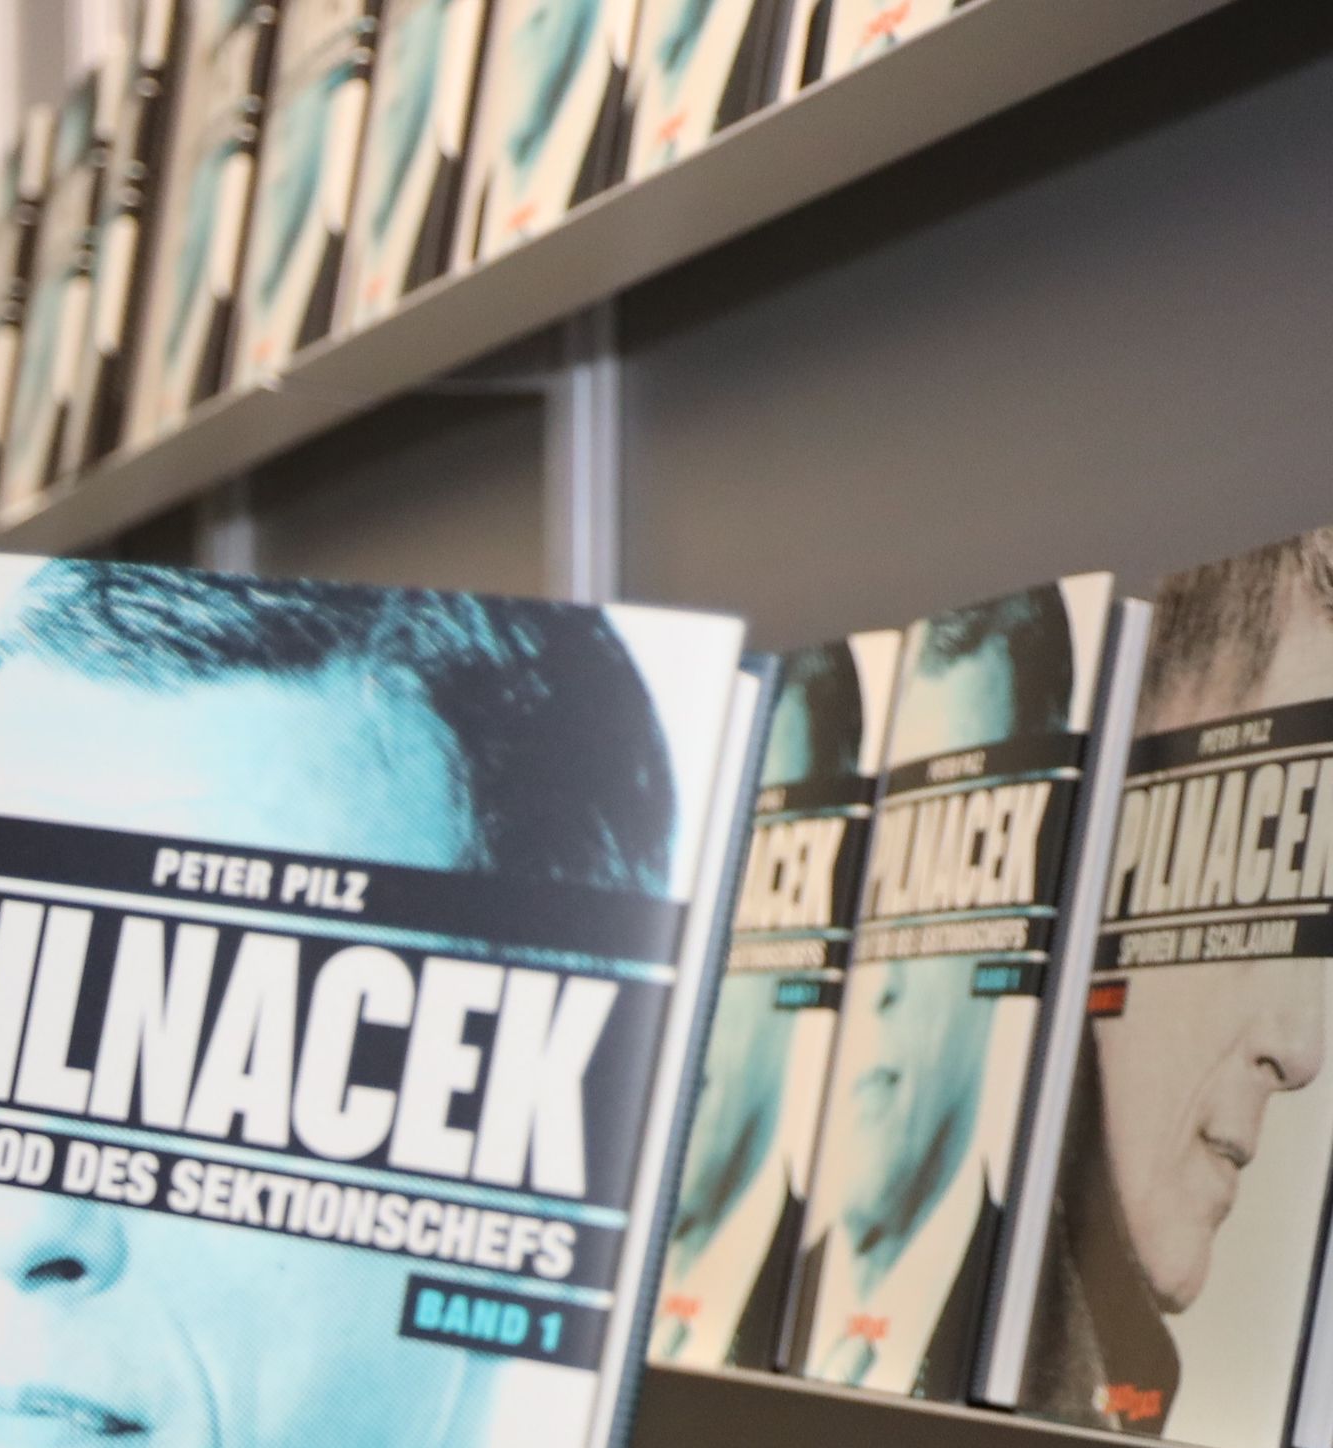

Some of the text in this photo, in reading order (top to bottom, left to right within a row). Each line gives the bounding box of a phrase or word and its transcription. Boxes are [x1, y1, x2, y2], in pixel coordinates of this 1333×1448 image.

[153, 848, 369, 912] PETER PILZ
[63, 1141, 158, 1204] DES
[168, 1162, 575, 1279] SEKTIONSCHEFS
[414, 1287, 562, 1351] BAND 1
